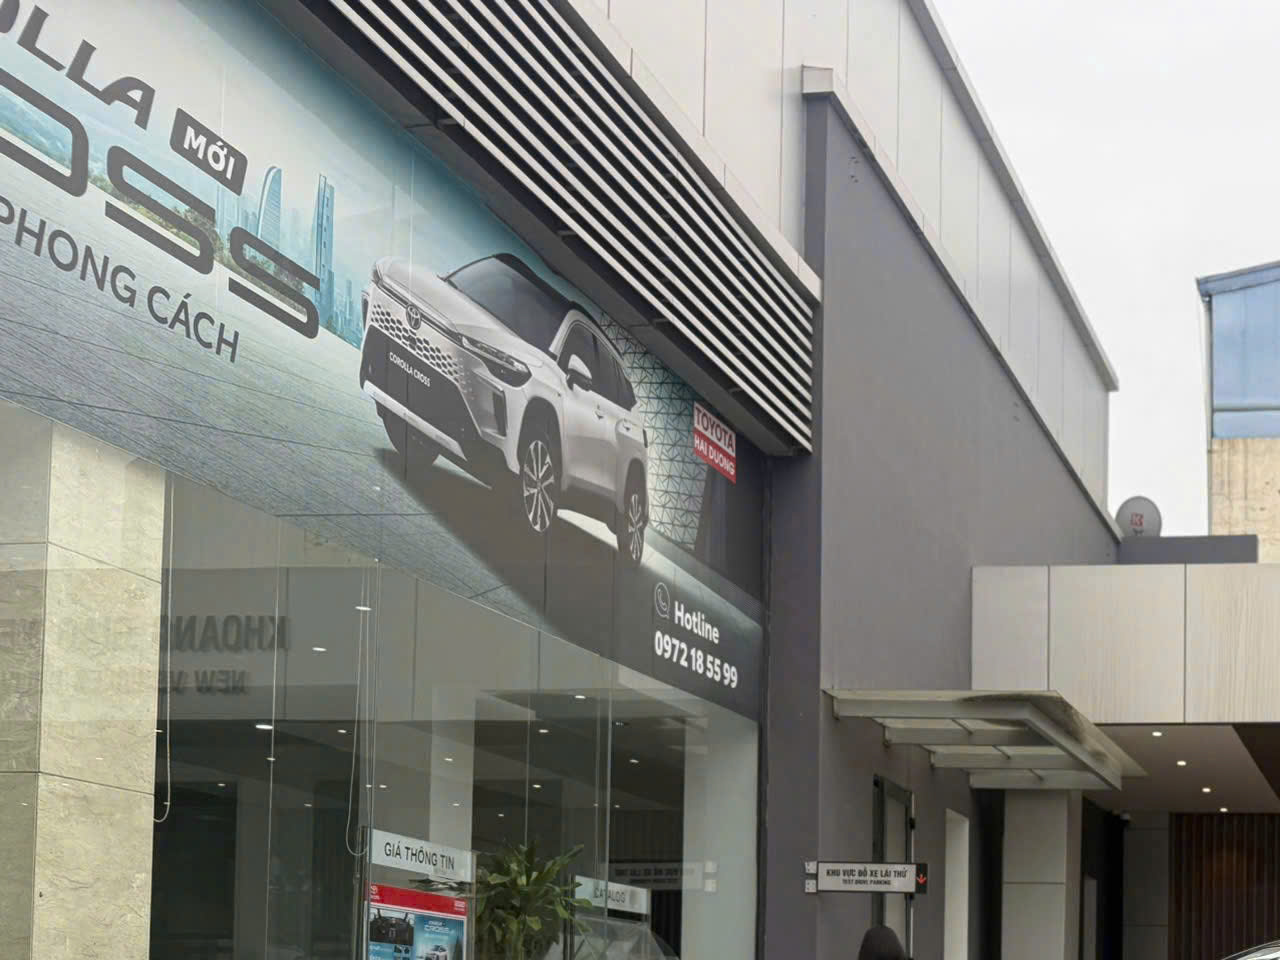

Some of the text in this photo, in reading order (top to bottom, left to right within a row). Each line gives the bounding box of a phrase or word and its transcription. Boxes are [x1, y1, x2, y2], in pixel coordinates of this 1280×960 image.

[183, 126, 235, 180] MỚI
[147, 285, 240, 363] CÁCH
[695, 434, 708, 456] HAI
[696, 406, 735, 453] TOYOTA
[674, 601, 719, 644] Hotline
[655, 630, 738, 688] 0972 18 55 99
[384, 841, 455, 870] GIÁ THÔNG TIN
[826, 868, 840, 877] KHU
[869, 869, 878, 878] XE
